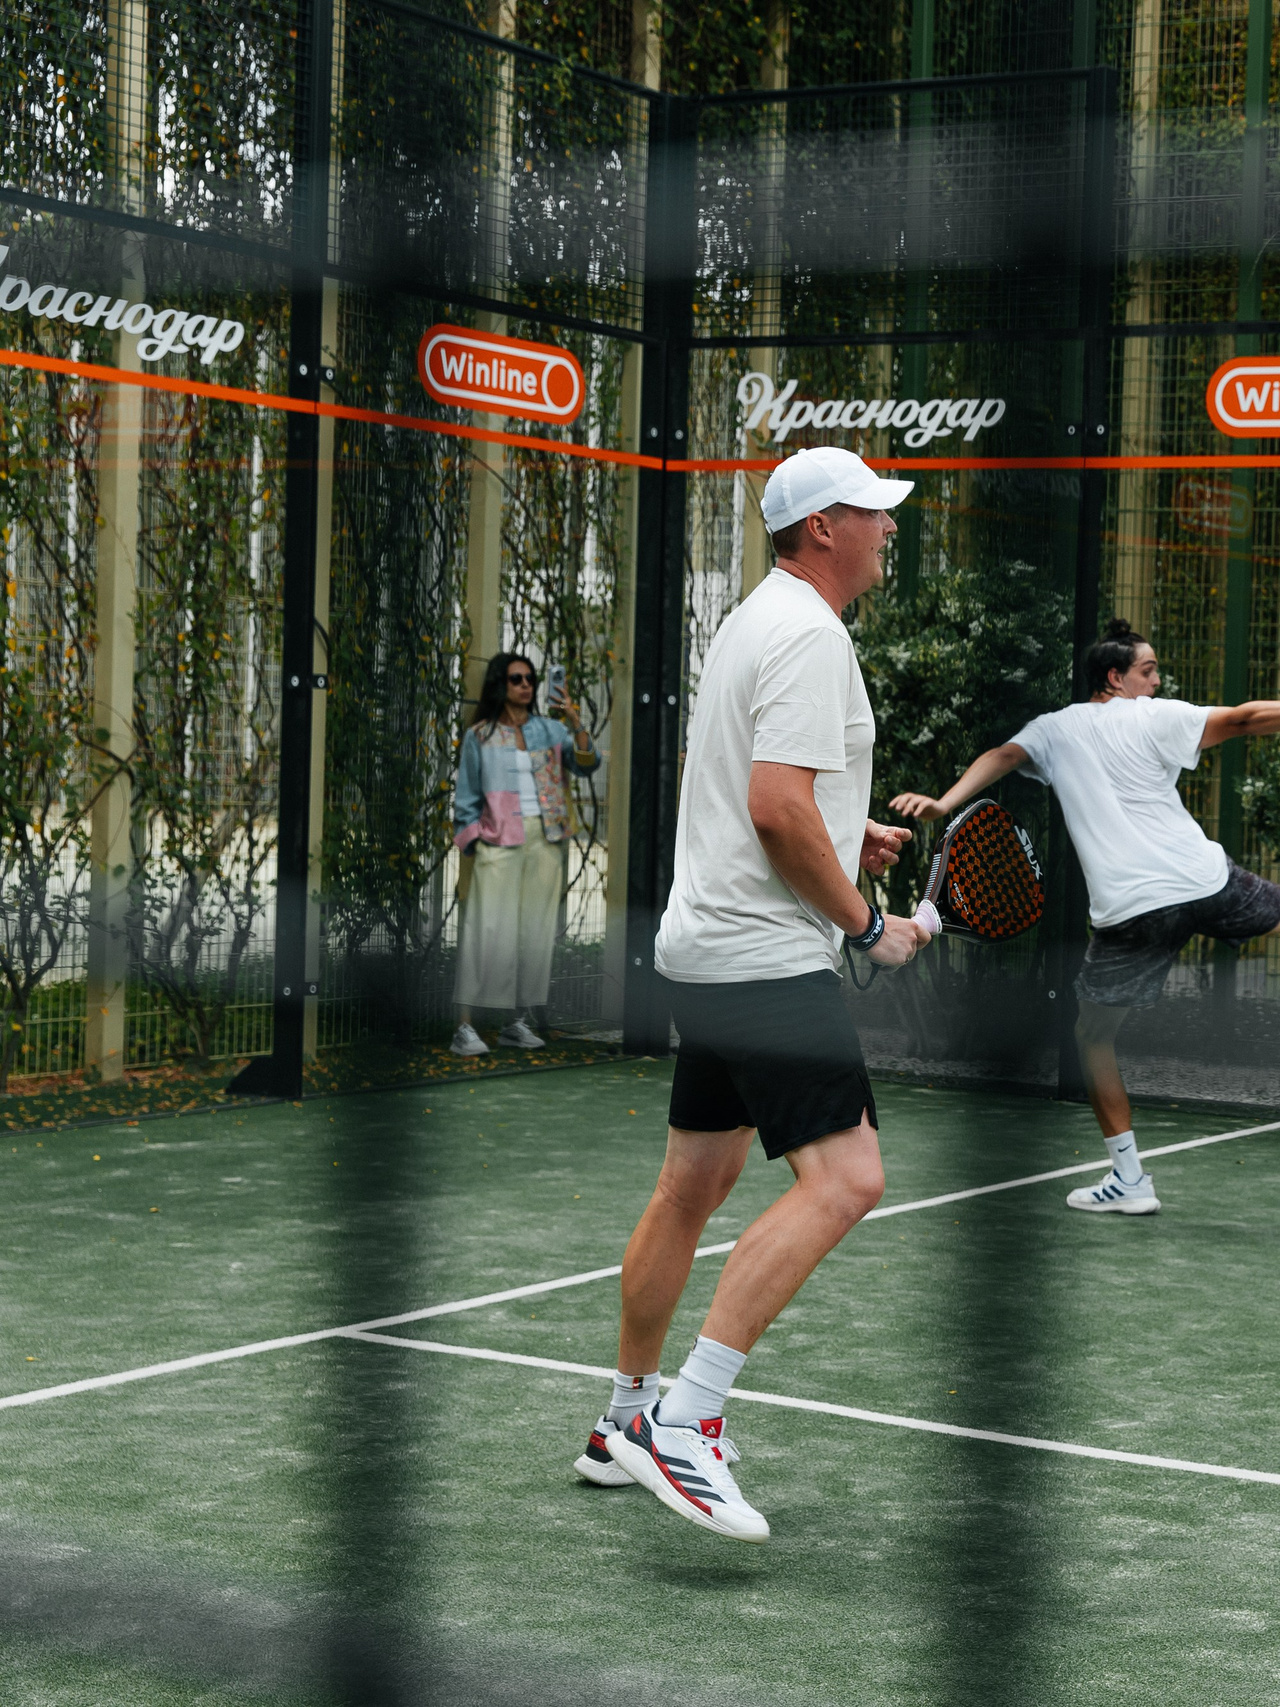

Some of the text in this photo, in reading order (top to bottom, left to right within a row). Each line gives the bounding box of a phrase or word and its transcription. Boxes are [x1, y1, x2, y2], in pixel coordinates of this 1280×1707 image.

[0, 245, 245, 365] раснодар
[440, 347, 537, 396] Winline
[736, 372, 1006, 448] Краснодар
